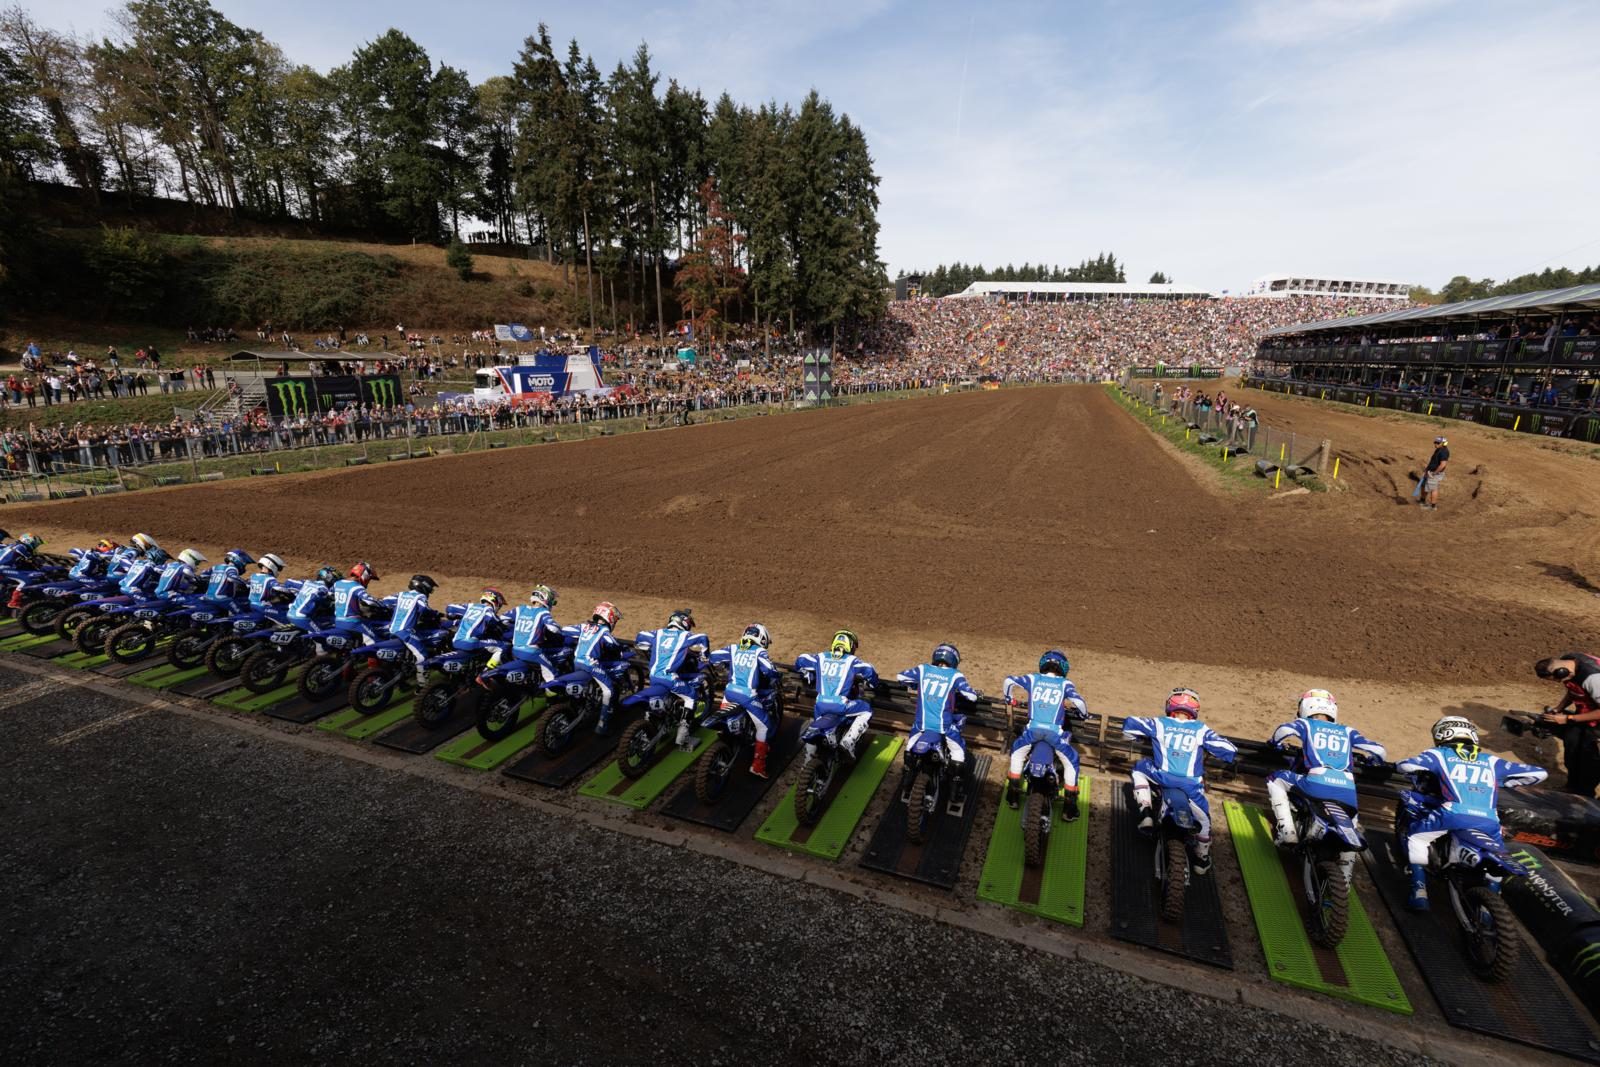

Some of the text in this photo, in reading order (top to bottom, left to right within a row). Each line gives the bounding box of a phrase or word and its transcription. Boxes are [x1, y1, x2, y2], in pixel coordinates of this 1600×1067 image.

[528, 377, 555, 386] MOTO
[274, 633, 291, 643] 747
[660, 637, 675, 649] 4
[449, 660, 459, 671] 12
[733, 653, 756, 668] 465
[821, 661, 847, 678] 981
[923, 678, 949, 698] 111
[1032, 686, 1062, 705] 643
[1164, 733, 1197, 753] 119
[1313, 732, 1350, 753] 667
[1450, 763, 1496, 789] 474
[1527, 869, 1573, 917] MONSTER
